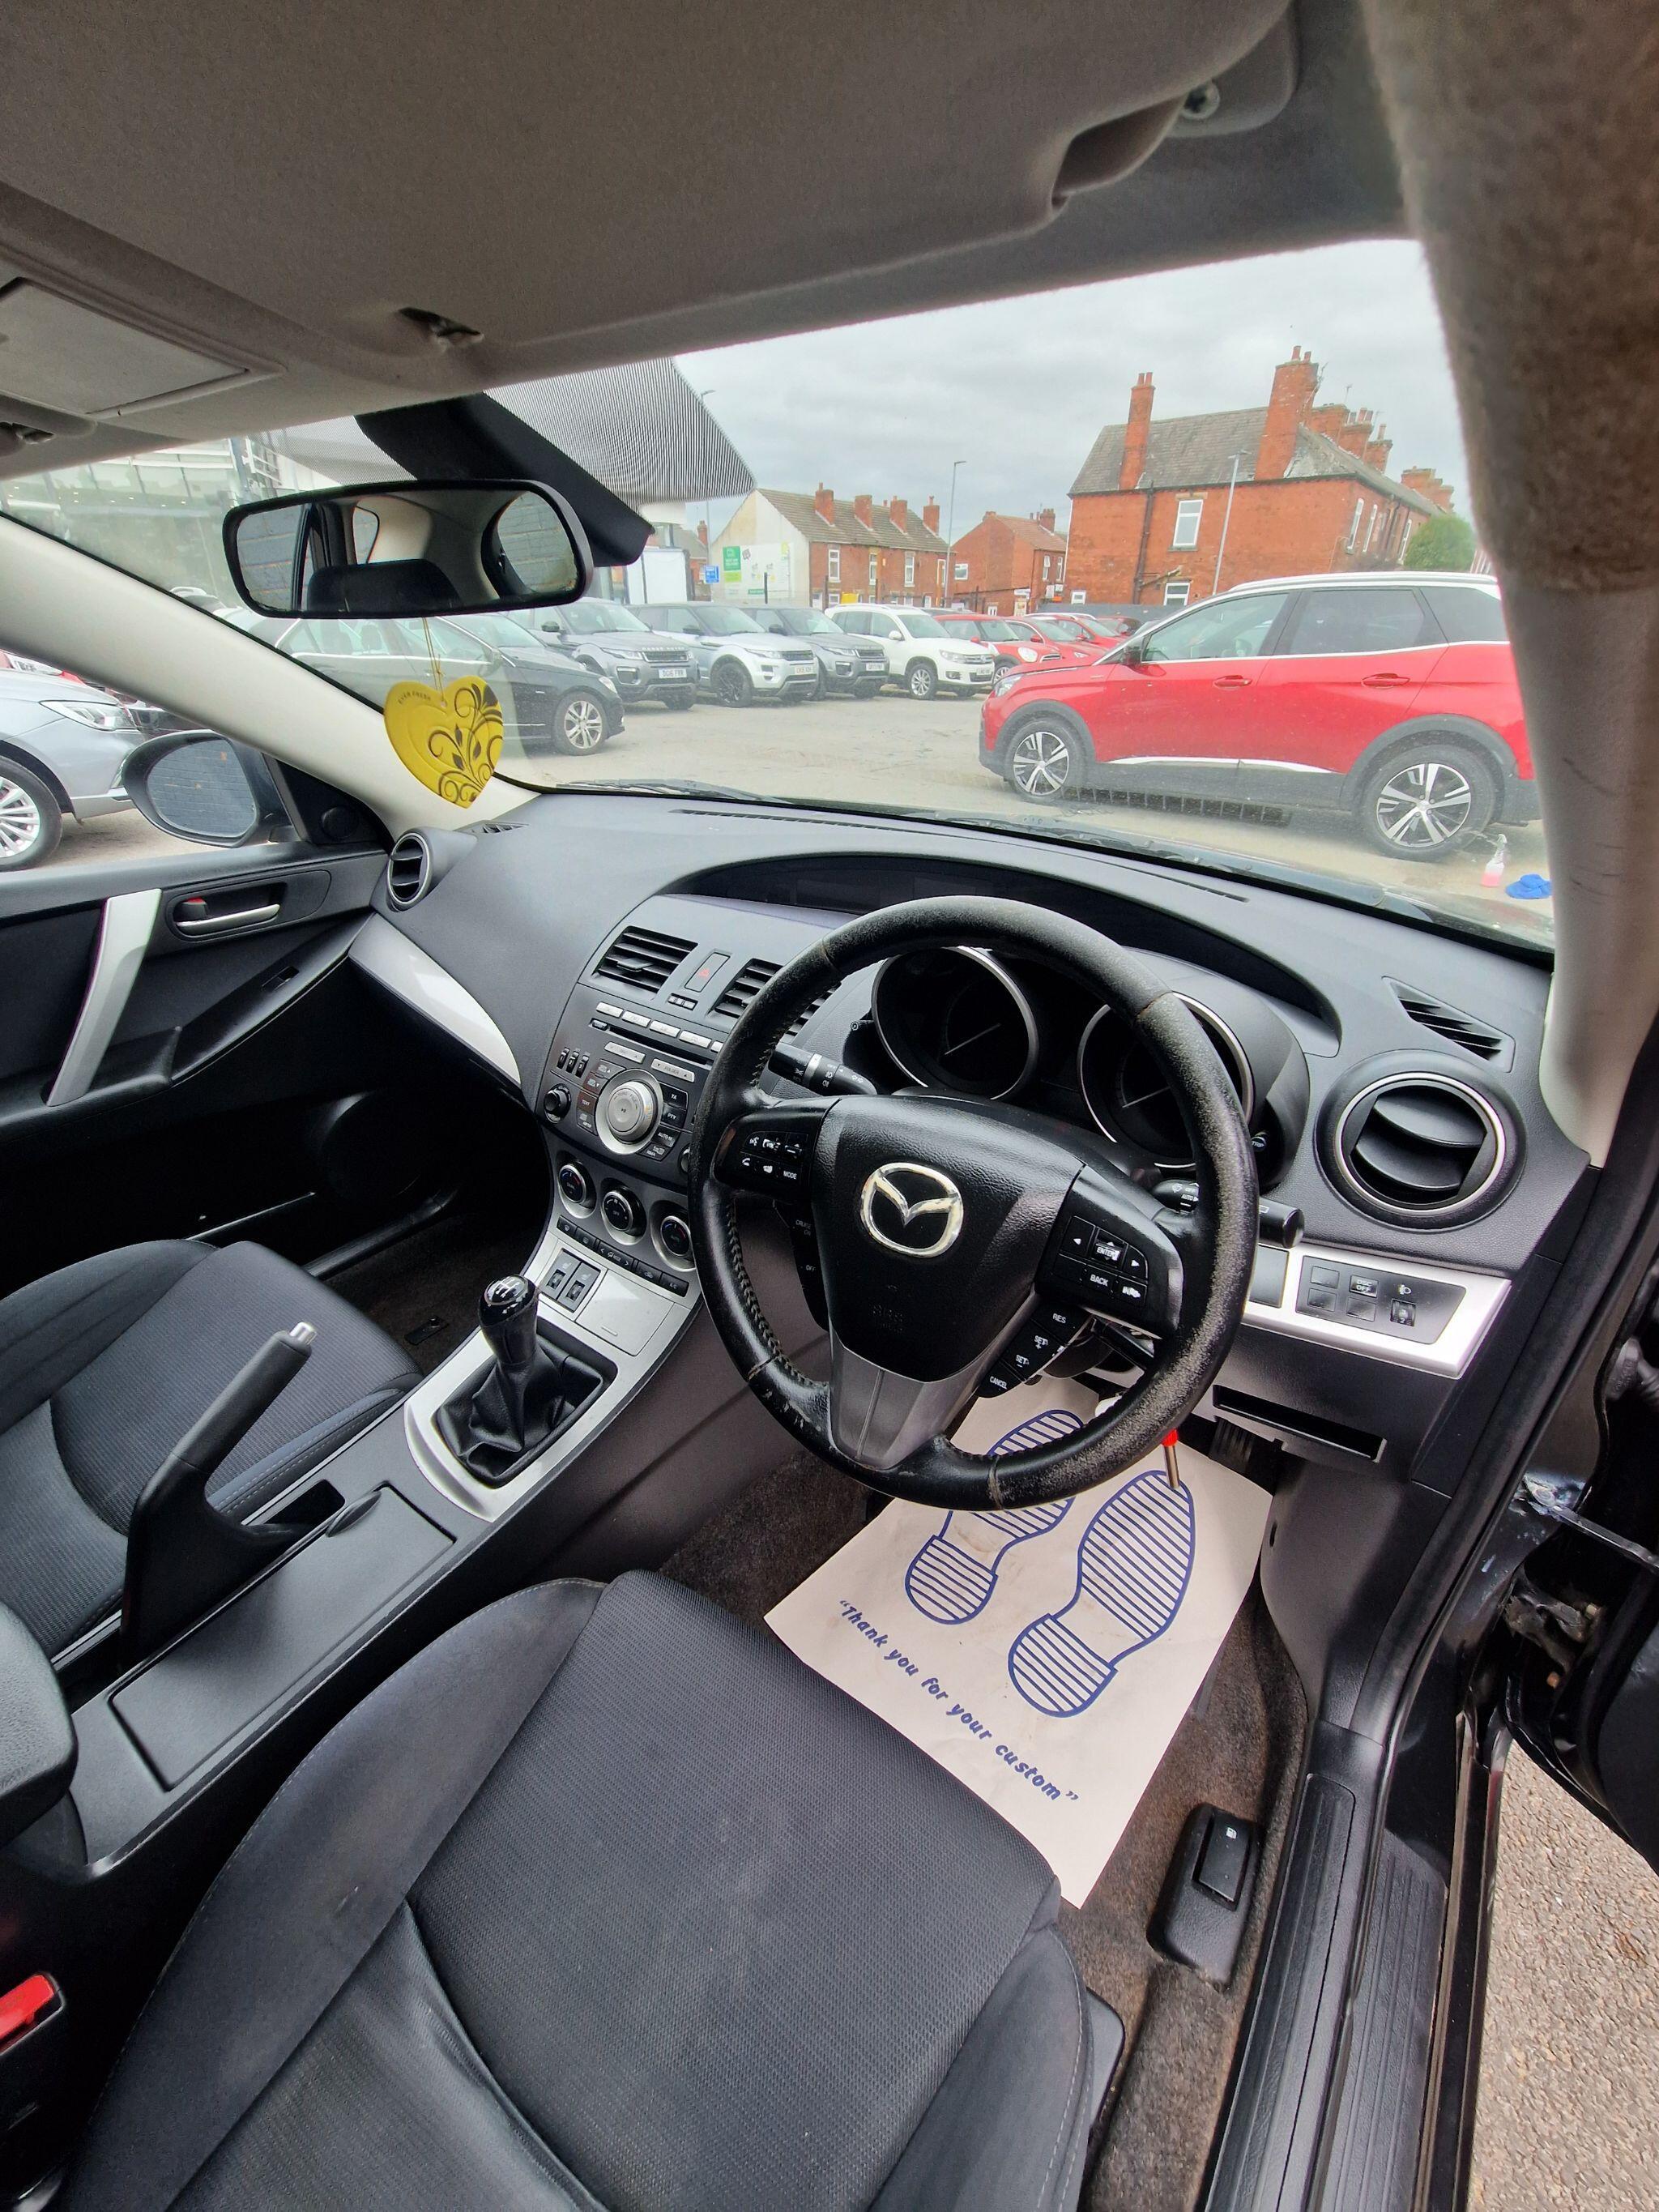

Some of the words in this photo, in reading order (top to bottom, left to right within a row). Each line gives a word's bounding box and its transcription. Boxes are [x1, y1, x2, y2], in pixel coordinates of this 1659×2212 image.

[783, 1170, 797, 1180] MODE
[805, 1264, 816, 1272] OFF
[1090, 1274, 1108, 1287] BACK
[1356, 1285, 1372, 1293] OFF
[1052, 1313, 1066, 1324] RES
[989, 1376, 1007, 1390] CANCEL
[883, 1647, 919, 1676] you
[921, 1676, 949, 1700] for
[945, 1703, 992, 1740] your
